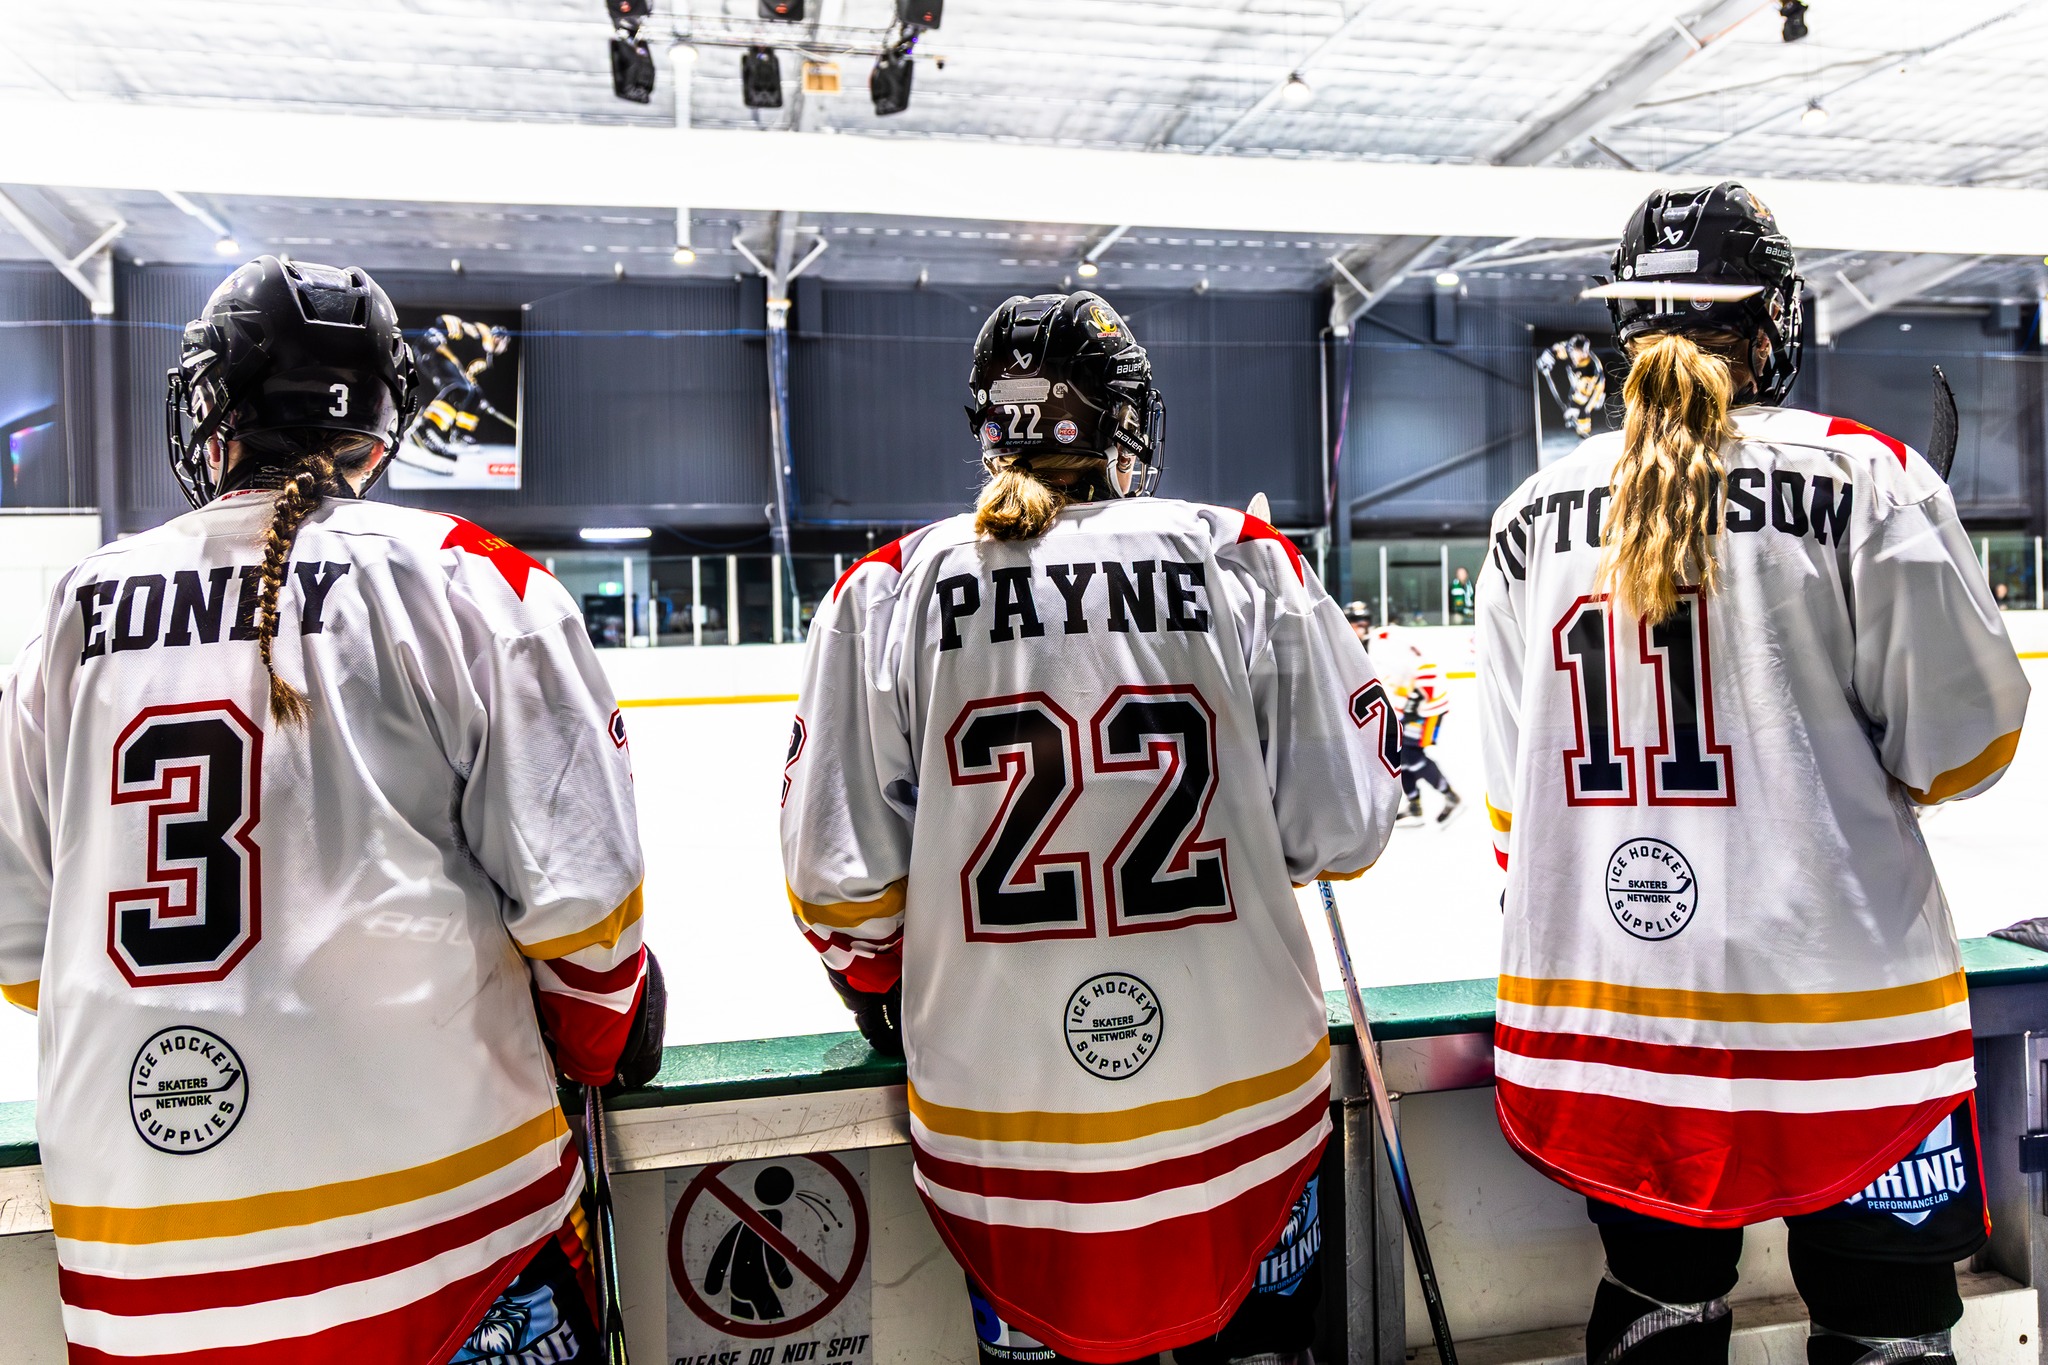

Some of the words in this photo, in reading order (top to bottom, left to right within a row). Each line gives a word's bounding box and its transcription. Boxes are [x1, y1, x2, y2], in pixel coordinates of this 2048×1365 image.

[328, 383, 349, 417] 3
[1003, 404, 1043, 439] 22
[935, 560, 1209, 652] PAYNE
[1552, 586, 1736, 807] 11
[944, 684, 1238, 943] 22
[107, 699, 264, 988] 3
[1611, 857, 1628, 883] ICE
[1629, 846, 1688, 880] HOCKEY
[1627, 893, 1672, 904] NETWORK
[1628, 880, 1668, 889] SKATERS
[1614, 901, 1688, 932] SUPPLIES
[1071, 995, 1091, 1023] ICE
[1092, 981, 1153, 1012] HOCKEY
[1091, 1028, 1138, 1042] NETWORK
[1092, 1015, 1134, 1028] SKATERS
[136, 1052, 158, 1087] ICE
[159, 1036, 235, 1075] HOCKEY
[1076, 1033, 1153, 1073] SUPPLIES
[158, 1077, 208, 1091] SKATERS
[156, 1094, 213, 1109] NETWORK
[139, 1100, 235, 1145] SUPPLIES
[1867, 1196, 1934, 1210] PERFORMANCE
[1934, 1191, 1949, 1204] LAB
[781, 1341, 820, 1364] NOT
[826, 1335, 869, 1358] SPIT
[1012, 1350, 1056, 1361] SOLUTIONS
